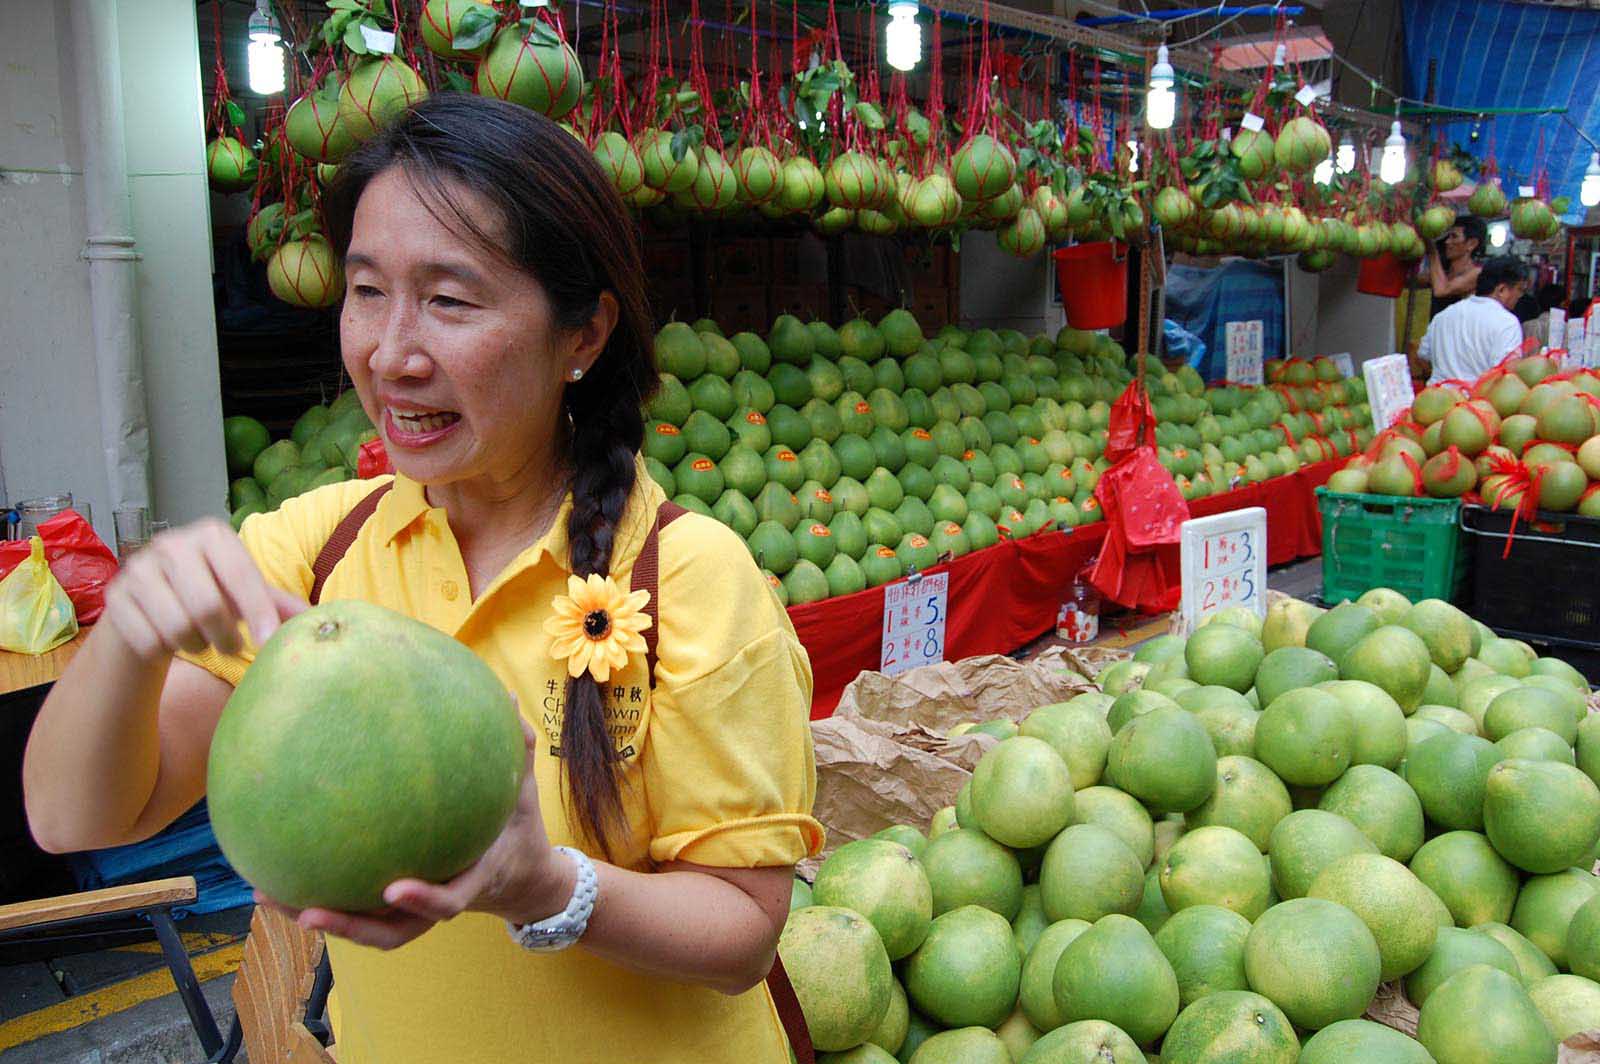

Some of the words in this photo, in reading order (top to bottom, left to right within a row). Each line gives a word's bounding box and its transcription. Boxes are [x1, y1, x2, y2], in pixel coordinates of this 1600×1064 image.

[1203, 540, 1209, 569] 1
[1202, 581, 1216, 611] 2
[888, 610, 893, 633] 1
[883, 642, 896, 667] 2
